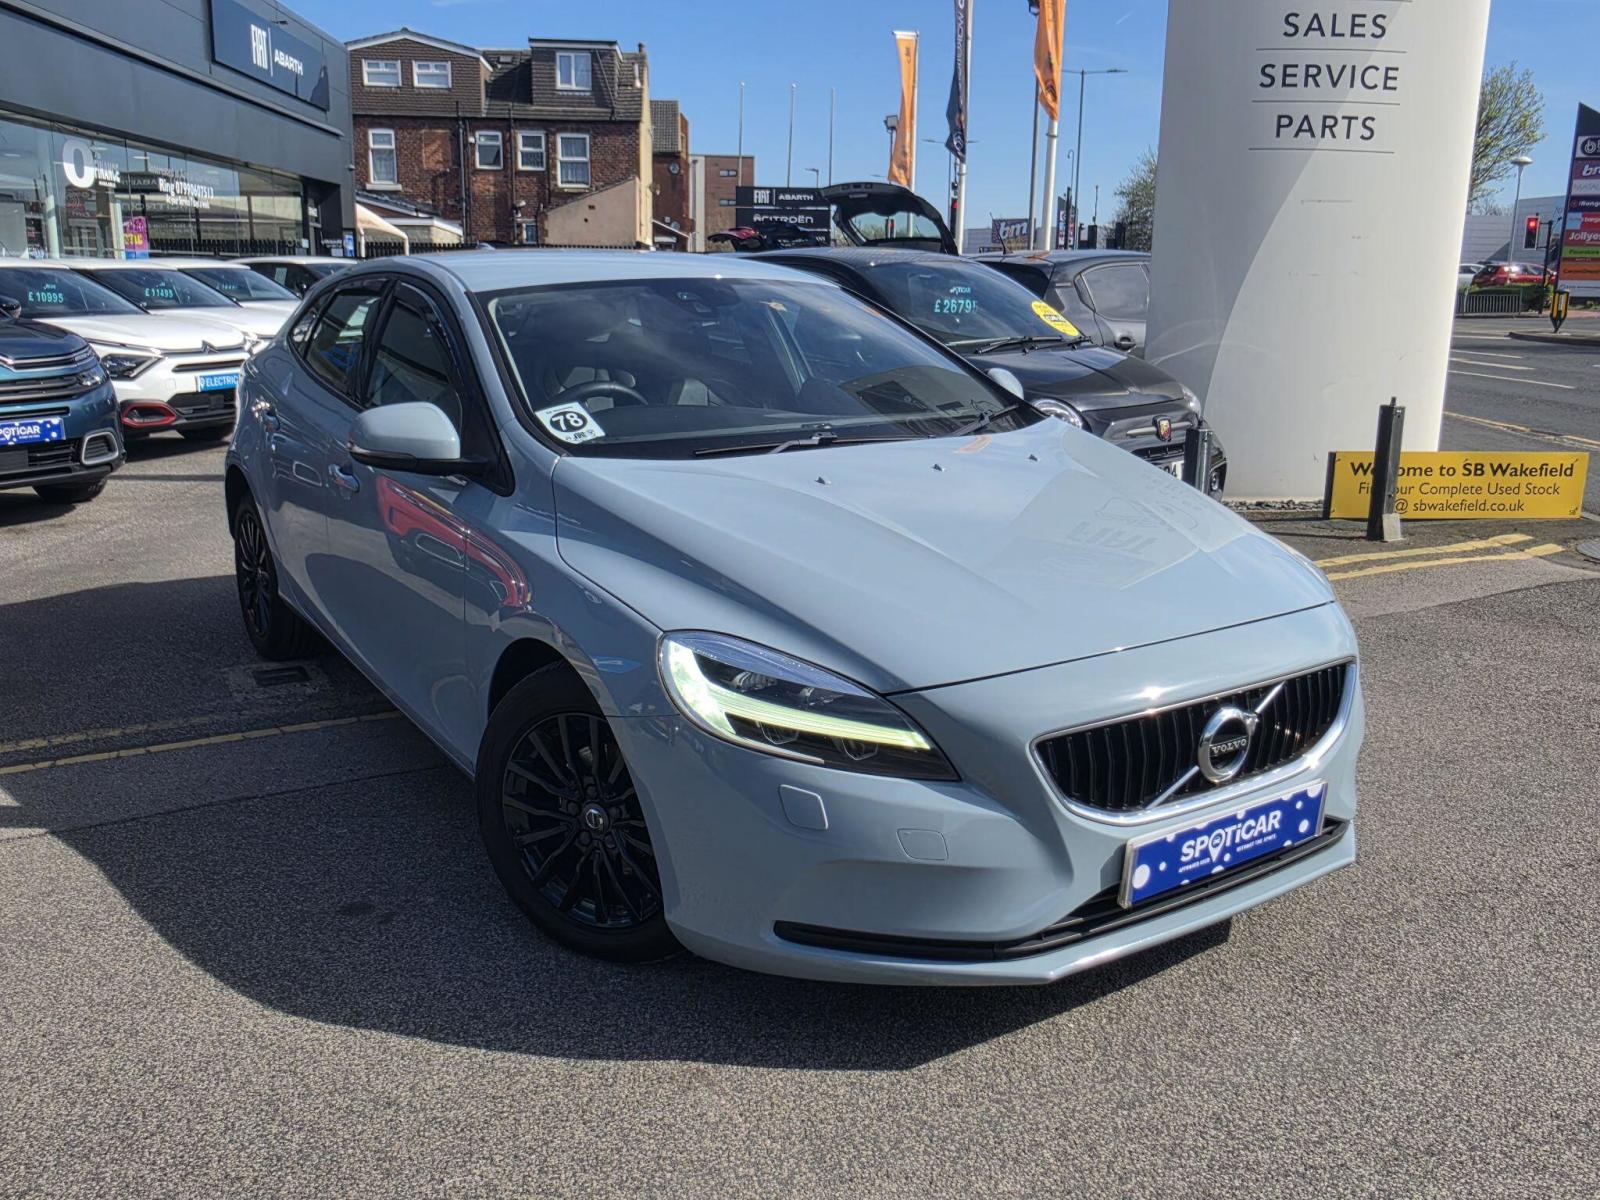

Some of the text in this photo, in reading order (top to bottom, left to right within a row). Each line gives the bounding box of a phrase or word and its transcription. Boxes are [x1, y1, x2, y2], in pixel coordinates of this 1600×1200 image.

[1282, 12, 1388, 39] SALES
[251, 24, 304, 76] FIAT ABARTH
[1259, 64, 1399, 91] SERVICE
[1275, 114, 1376, 141] PARTS
[753, 190, 814, 204] FIAT ABARTH
[551, 412, 584, 431] 78
[1350, 462, 1575, 477] Wome to SB Wakefield
[1419, 482, 1483, 498] Complete
[1487, 482, 1520, 495] Used
[1524, 482, 1560, 495] Stock
[1412, 499, 1525, 512] sbwakefield.co.uk
[1211, 738, 1247, 754] VOLVO
